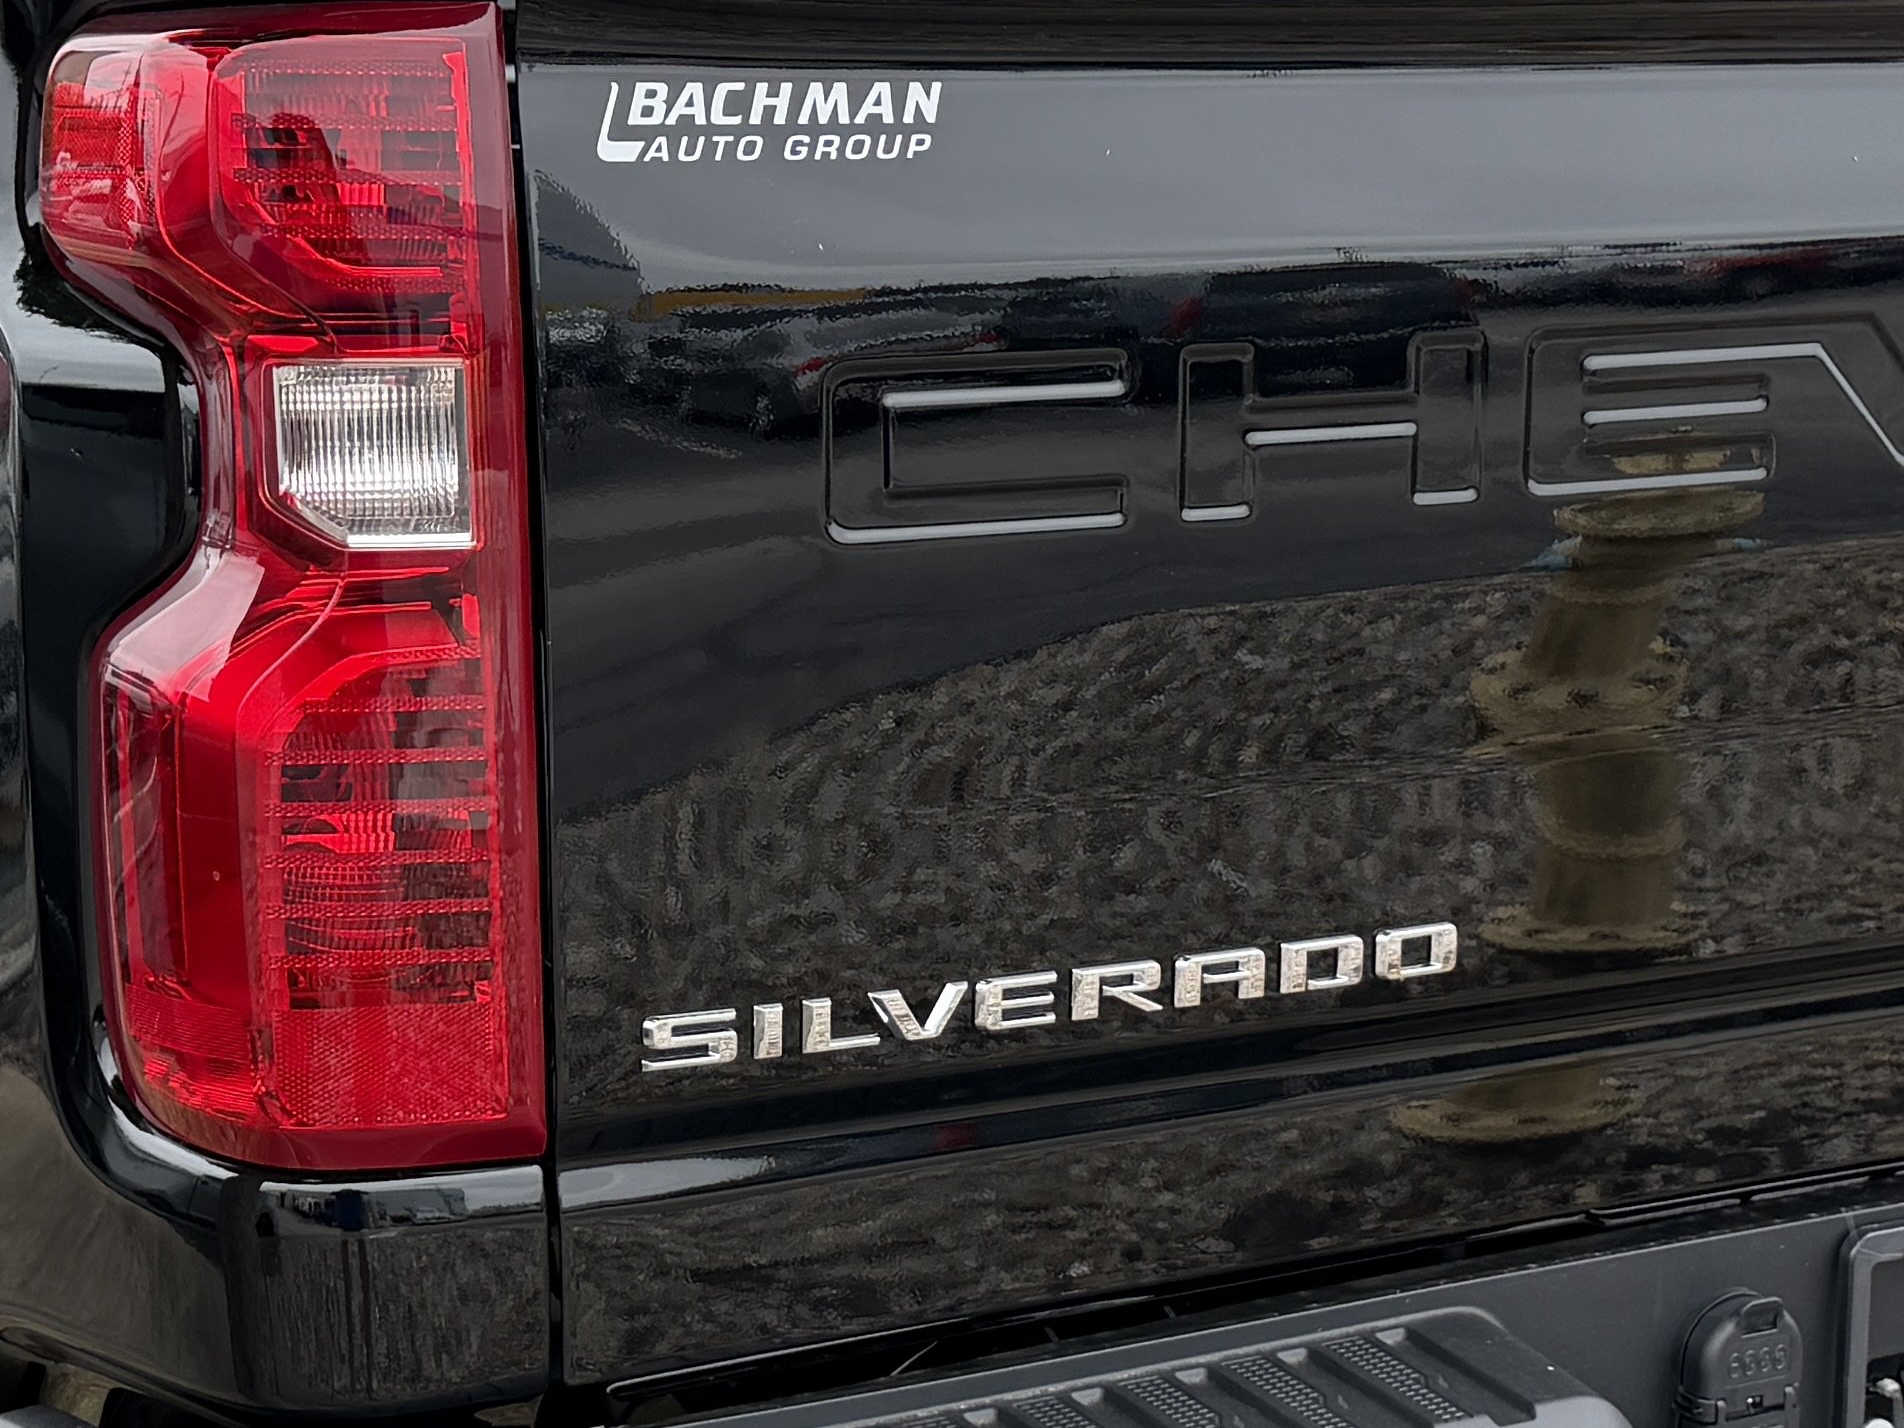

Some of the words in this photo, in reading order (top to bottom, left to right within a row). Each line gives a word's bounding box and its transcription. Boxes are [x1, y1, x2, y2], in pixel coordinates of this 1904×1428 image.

[627, 81, 942, 125] BACHMAN
[643, 135, 764, 162] AUTO
[783, 133, 933, 162] GROUP
[640, 920, 1458, 1074] SILVERADO
